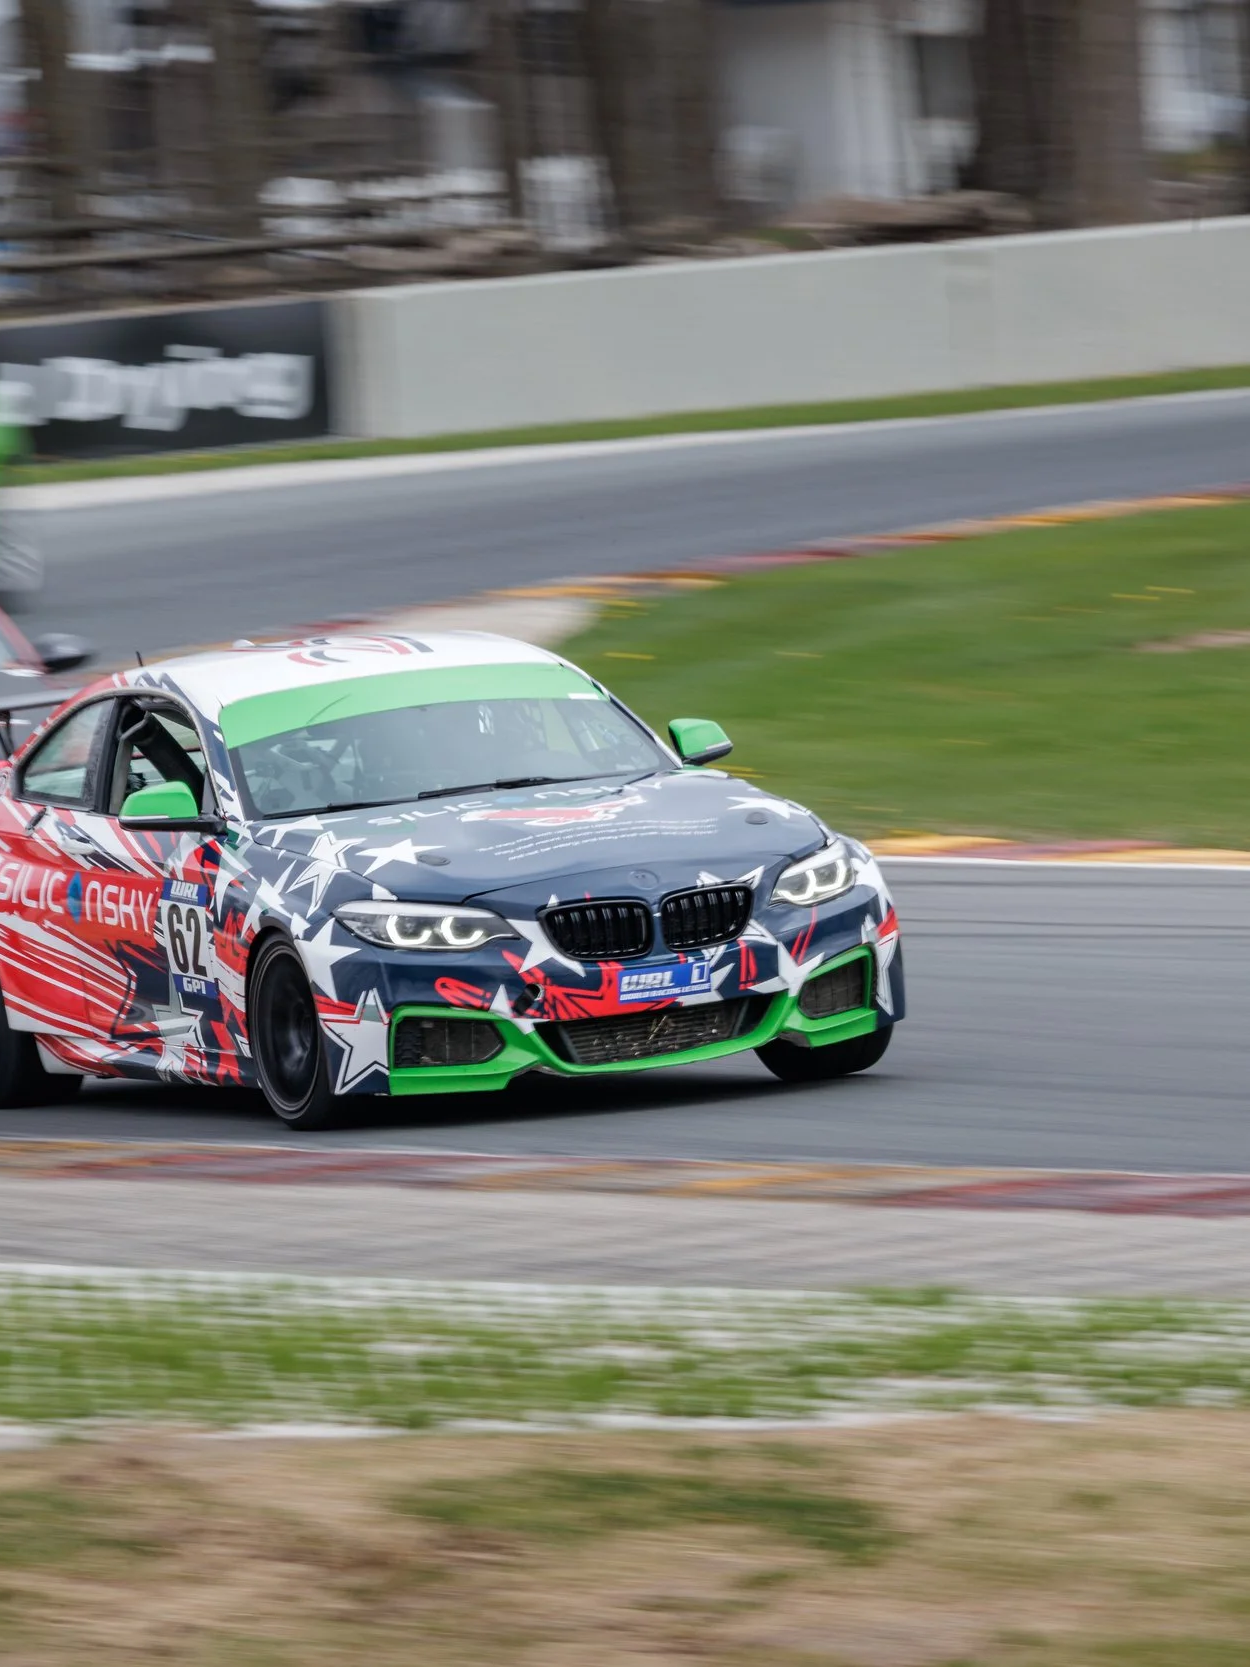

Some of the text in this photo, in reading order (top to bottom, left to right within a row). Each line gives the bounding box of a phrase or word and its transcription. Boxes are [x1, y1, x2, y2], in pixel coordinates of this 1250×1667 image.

[170, 880, 199, 899] WRL
[167, 903, 208, 978] 62
[620, 971, 675, 992] WRL
